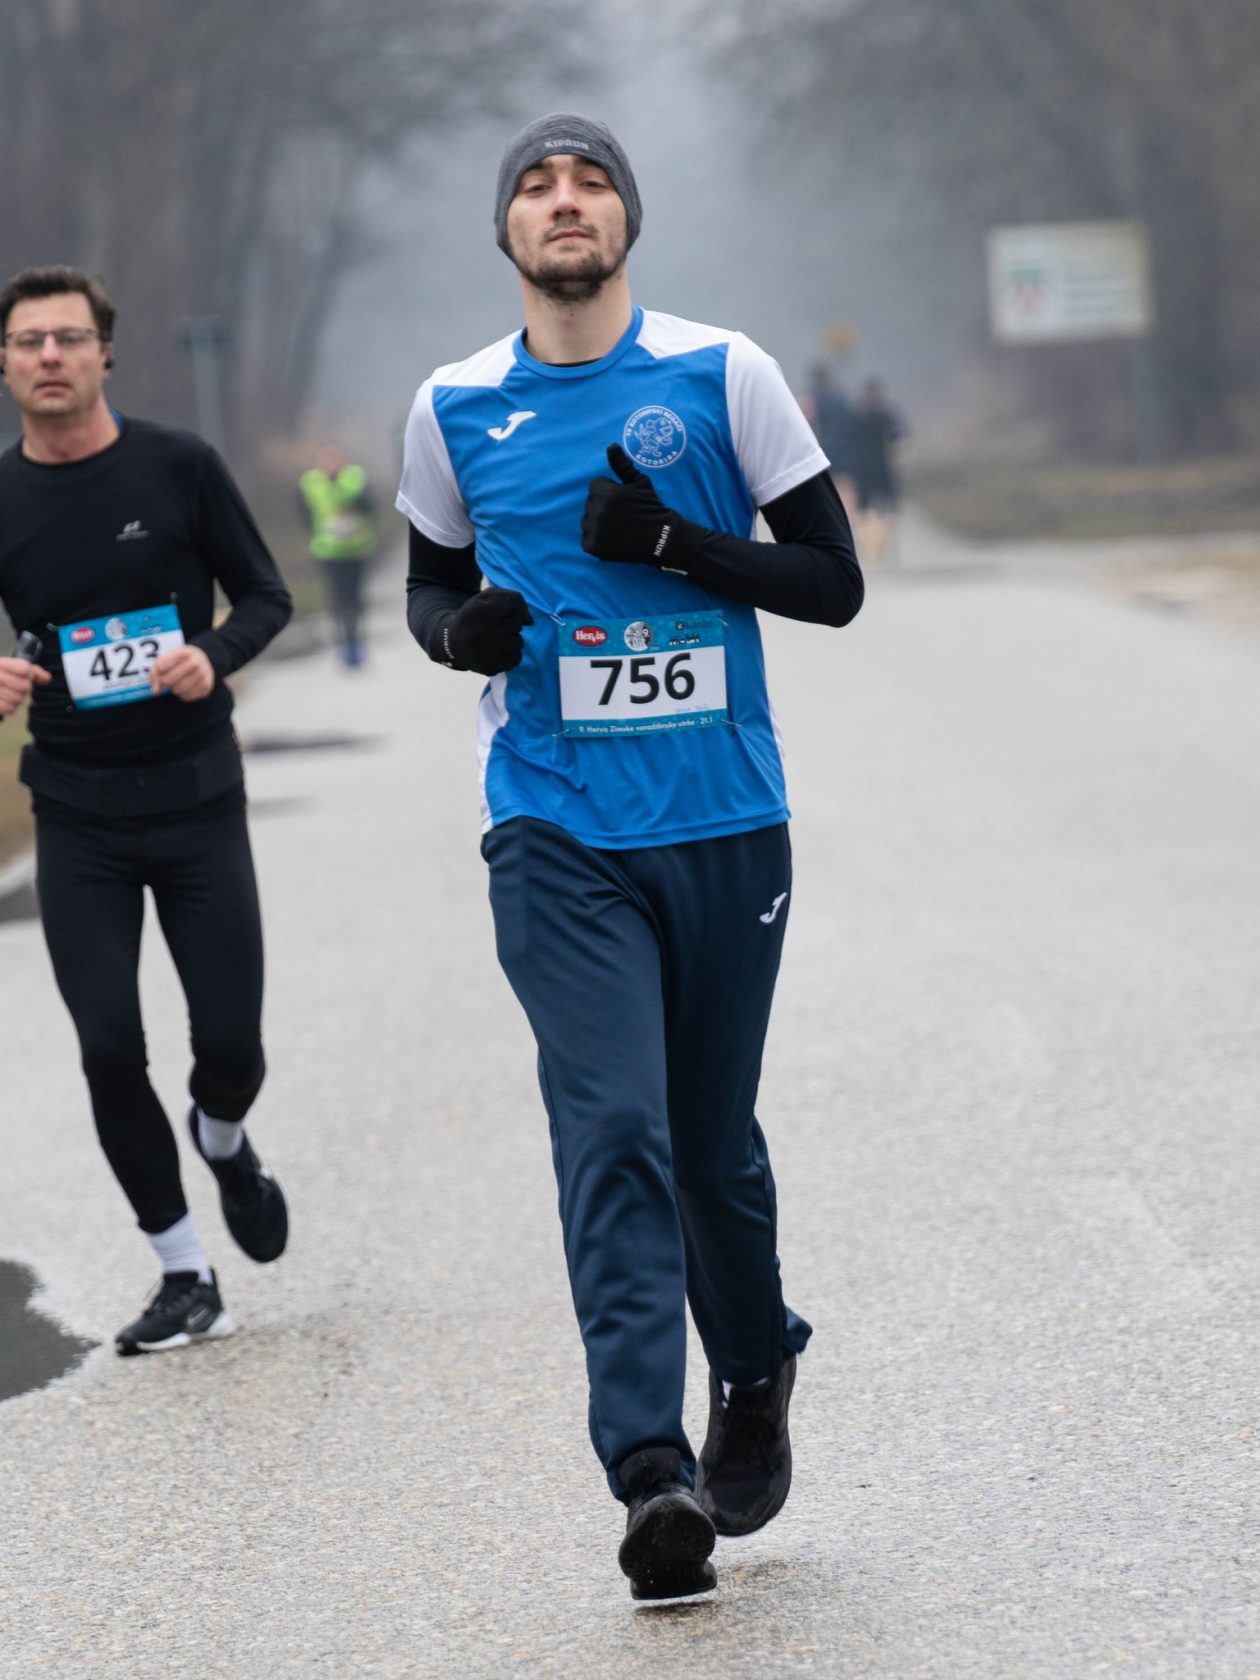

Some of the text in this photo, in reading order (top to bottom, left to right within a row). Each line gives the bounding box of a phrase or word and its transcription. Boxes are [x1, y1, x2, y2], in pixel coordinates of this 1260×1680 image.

[544, 139, 589, 151] KIPRUN
[635, 451, 678, 465] KOTORIBA
[653, 524, 671, 556] KIPRUN
[575, 630, 606, 642] Hervis
[590, 652, 696, 706] 756
